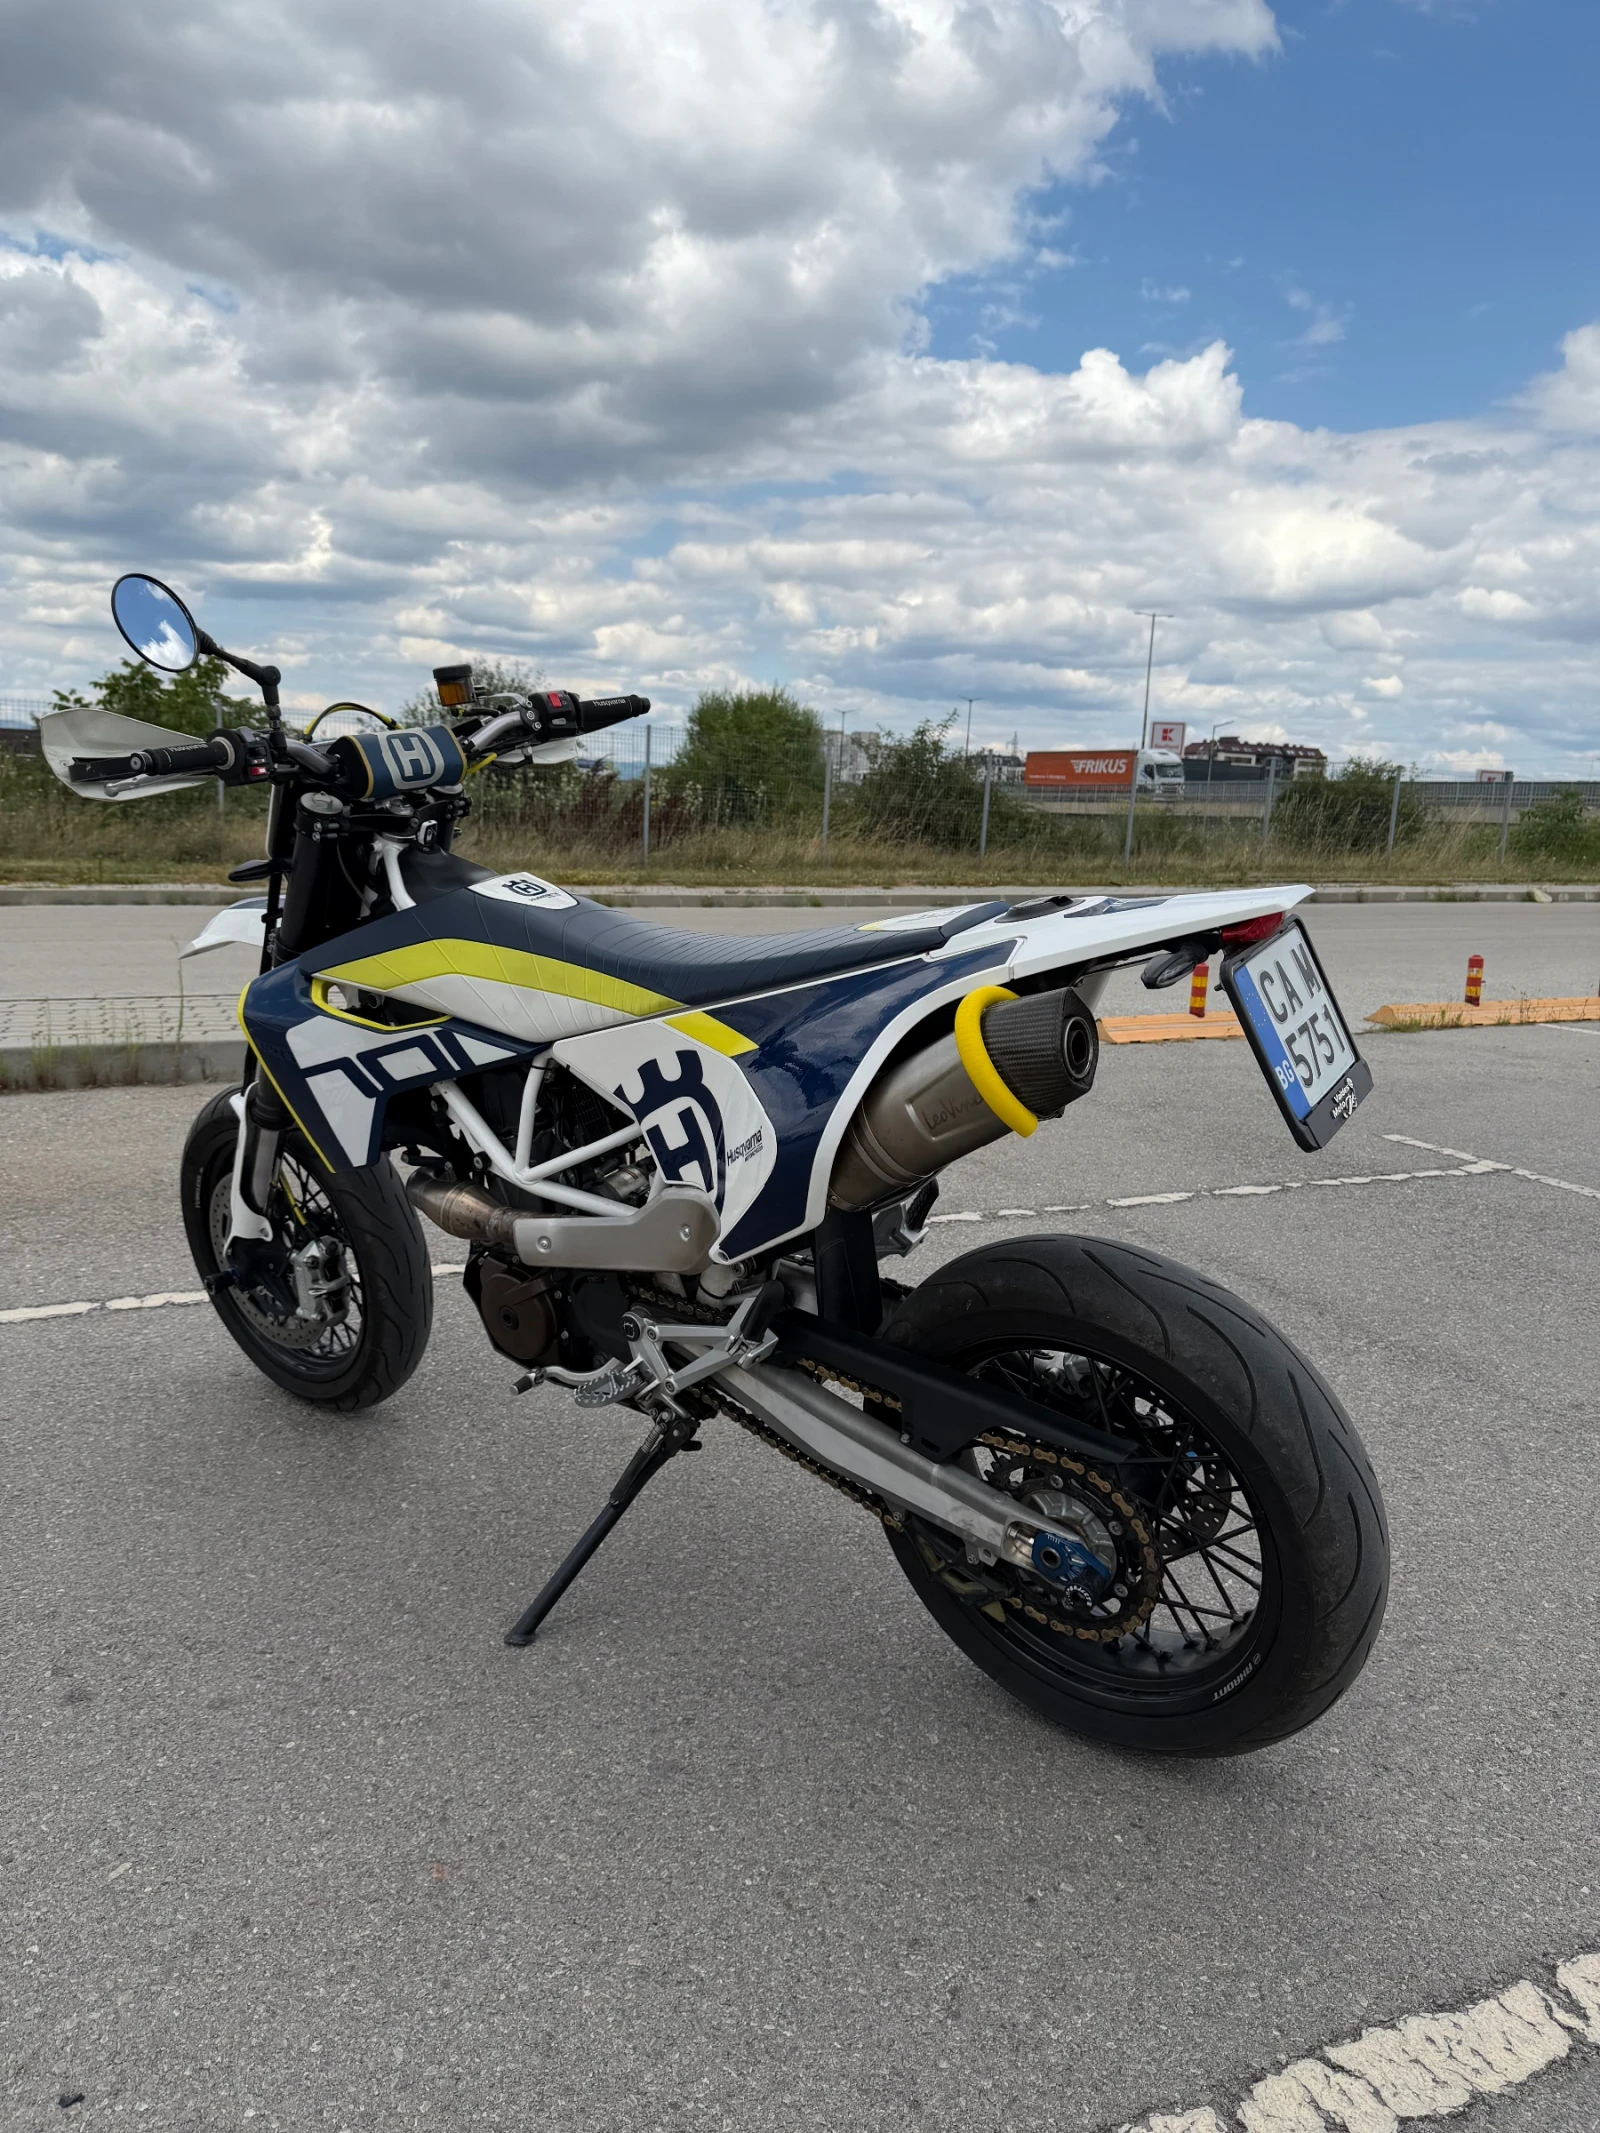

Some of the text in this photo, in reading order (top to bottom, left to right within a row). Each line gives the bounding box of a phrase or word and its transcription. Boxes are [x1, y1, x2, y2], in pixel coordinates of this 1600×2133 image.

[1161, 728, 1176, 742] K
[1073, 759, 1128, 774] FRIKUS
[1259, 943, 1322, 1024] CA M
[1285, 1003, 1346, 1088] 5751
[1274, 1059, 1296, 1091] BG
[921, 1094, 984, 1130] LeoVinc
[726, 1129, 763, 1167] Husqvarna
